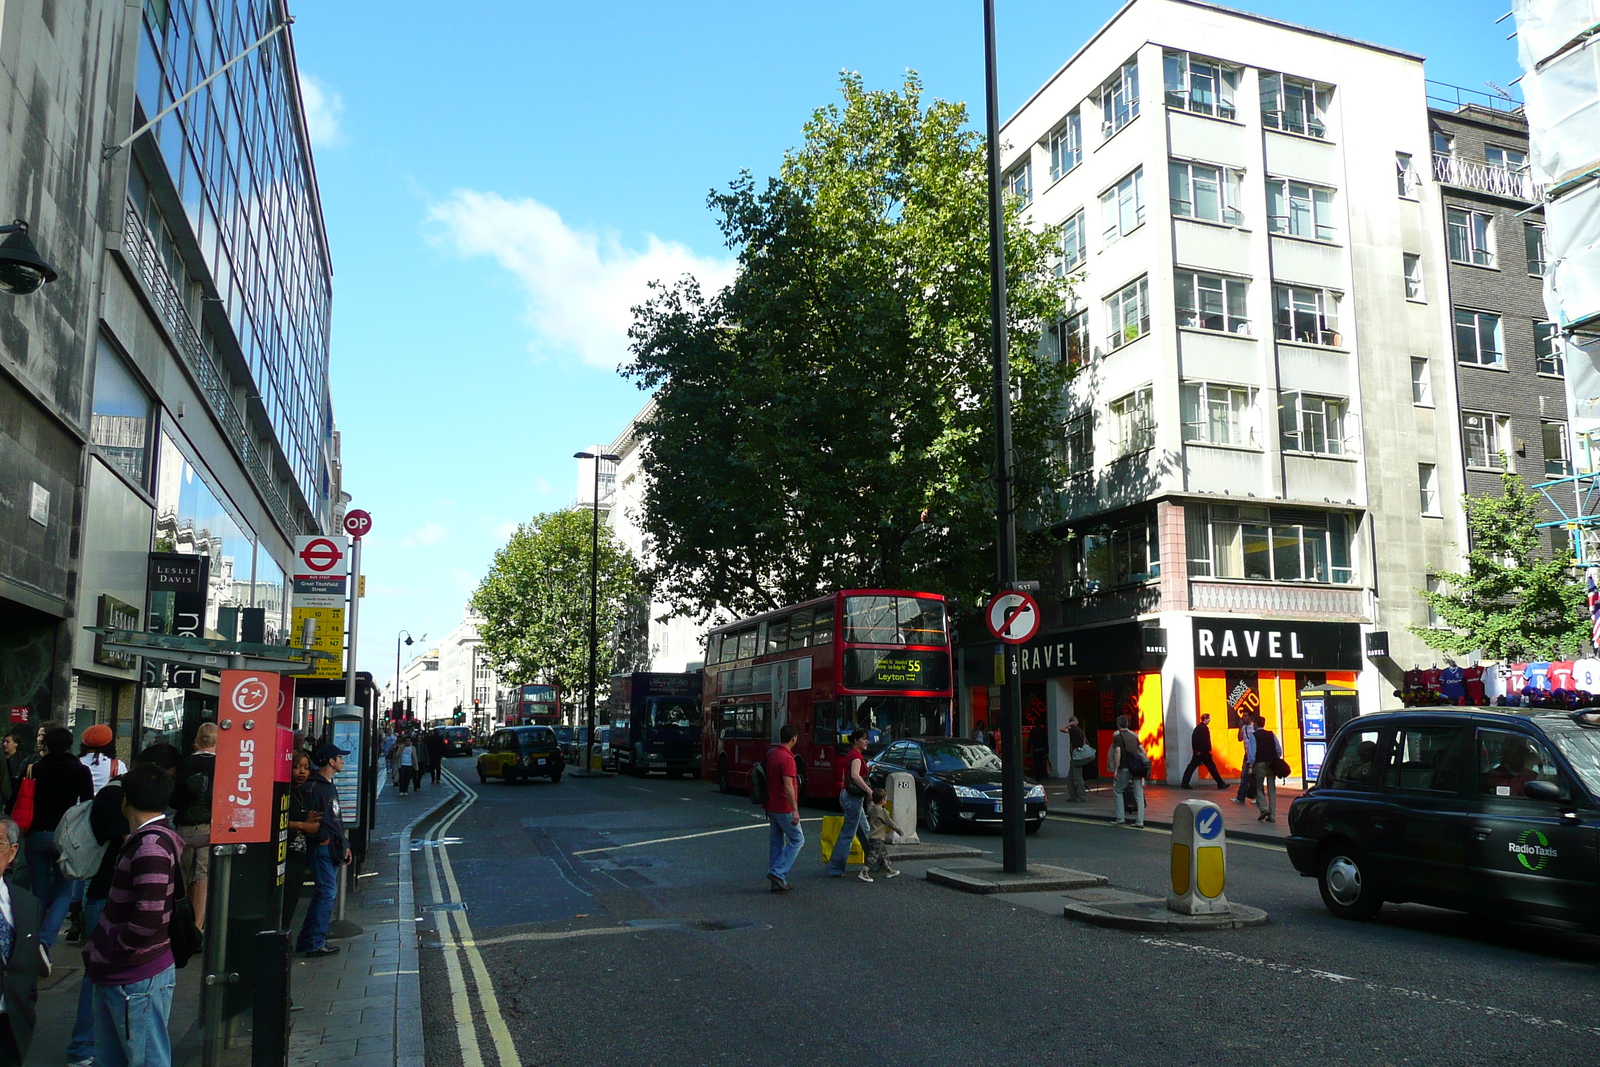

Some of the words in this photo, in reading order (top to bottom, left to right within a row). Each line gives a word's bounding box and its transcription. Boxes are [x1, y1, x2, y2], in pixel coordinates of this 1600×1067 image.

[347, 517, 368, 529] OP
[157, 566, 196, 575] LESLIE
[160, 575, 192, 583] DAVIS
[1199, 629, 1304, 659] RAVEL
[1021, 642, 1077, 671] RAVEL
[908, 660, 921, 672] 55
[878, 673, 905, 682] Leyton
[1511, 676, 1525, 691] 14
[1585, 671, 1592, 685] 8
[1026, 700, 1047, 724] £10
